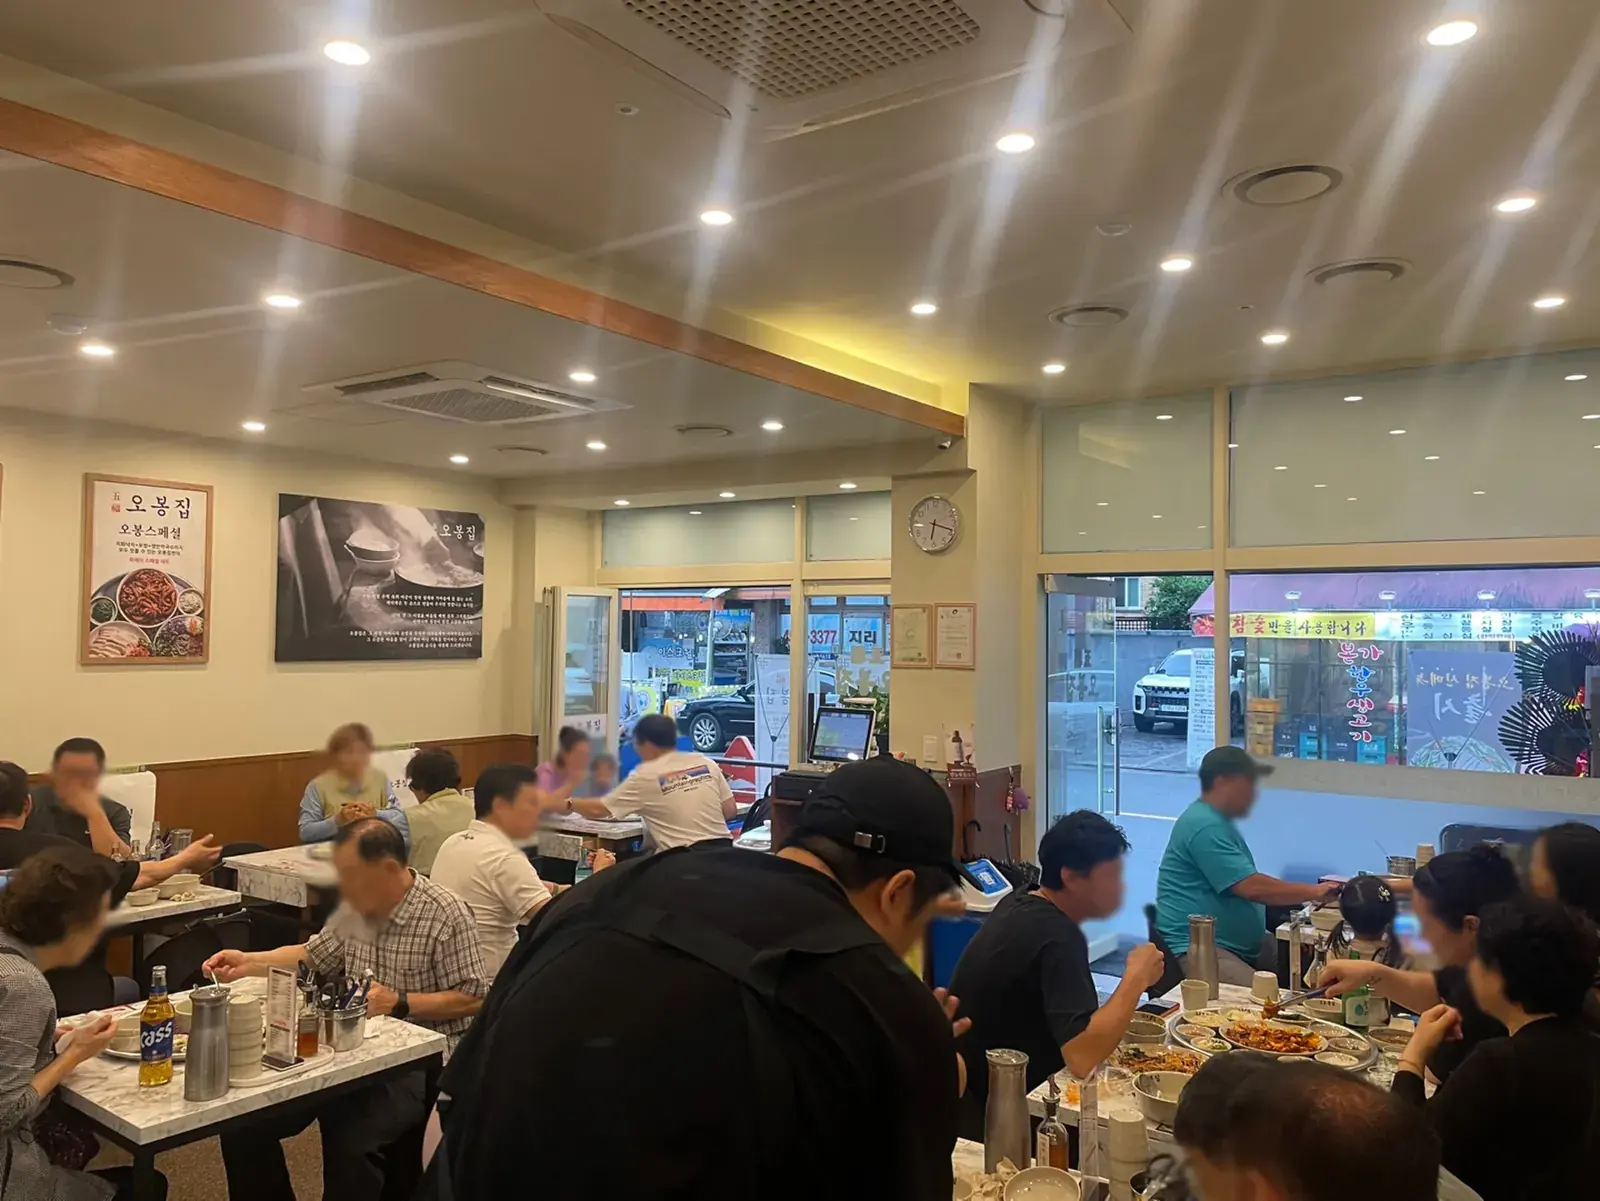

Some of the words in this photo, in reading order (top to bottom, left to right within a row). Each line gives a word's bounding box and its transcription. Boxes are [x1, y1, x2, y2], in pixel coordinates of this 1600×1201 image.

[126, 495, 190, 519] 오봉집
[119, 524, 181, 540] 오봉스페셜
[440, 524, 476, 541] 오봉집
[1298, 620, 1367, 636] 사용합니다
[849, 630, 877, 645] 지리
[1338, 641, 1383, 664] 본가
